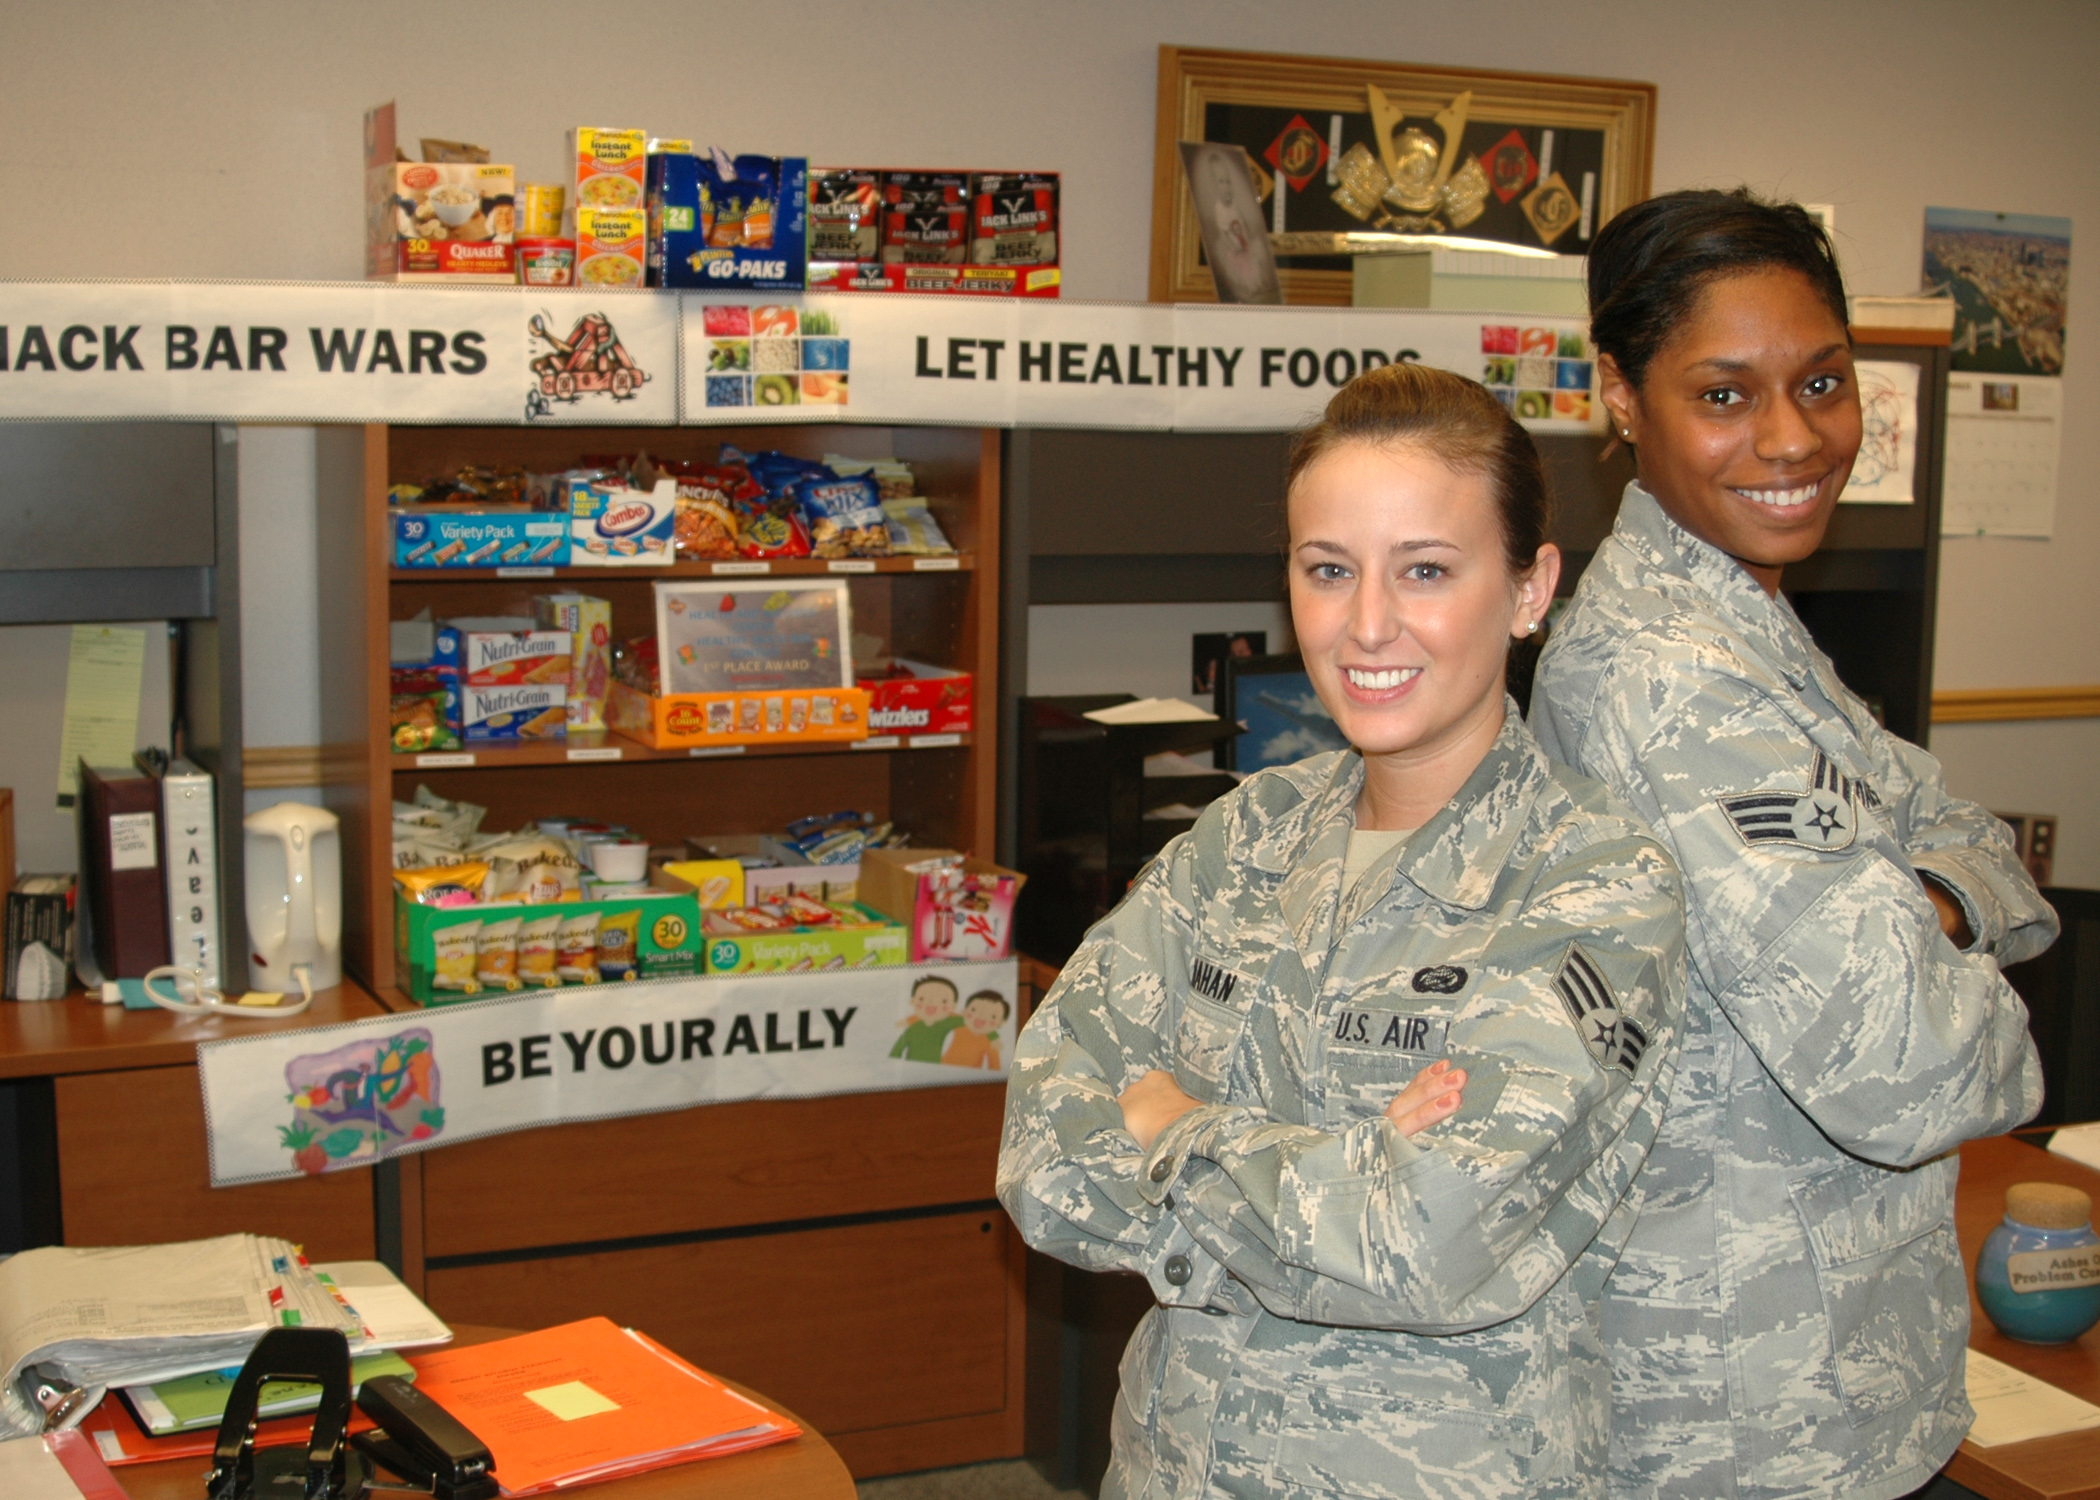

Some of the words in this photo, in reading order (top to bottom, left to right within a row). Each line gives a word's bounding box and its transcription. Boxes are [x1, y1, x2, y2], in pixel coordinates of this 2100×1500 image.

[591, 140, 632, 150] Instant
[595, 149, 627, 159] Lunch
[481, 168, 507, 176] NEW!
[668, 208, 690, 223] 24
[811, 203, 830, 215] ACK
[591, 220, 632, 230] Instant
[981, 213, 1008, 228] JACK
[1010, 210, 1047, 224] LINK'S
[595, 229, 627, 239] Lunch
[407, 238, 429, 253] 30
[450, 243, 504, 260] QUAKER
[707, 260, 787, 280] GO-PAKS
[912, 269, 950, 277] ORIGINAL
[971, 270, 1009, 278] TERIYAKI
[905, 278, 953, 290] BEEF
[953, 280, 1017, 293] JERKY
[0, 325, 145, 372] ACK
[164, 325, 288, 372] BAR
[309, 327, 488, 376] WARS
[915, 335, 1005, 380] LET
[1018, 340, 1244, 388] HEALTHY
[604, 504, 646, 528] Combos
[404, 521, 425, 538] 30
[440, 524, 483, 541] Variety
[485, 524, 515, 539] Pack
[569, 605, 579, 633] PACK
[480, 639, 556, 666] Nutri-Grain
[723, 660, 760, 672] PLACE
[764, 659, 810, 671] AWARD
[475, 689, 550, 718] Nutri-Grain
[669, 716, 700, 727] Count
[680, 709, 691, 718] 16
[868, 704, 930, 729] wizzlers
[658, 920, 683, 939] 30
[645, 952, 674, 964] Smart
[675, 950, 695, 961] Mix
[713, 943, 737, 964] 30
[752, 942, 799, 961] Variety
[800, 940, 831, 956] Pack
[1334, 1011, 1371, 1045] U.S.
[1381, 1015, 1429, 1051] AIR
[480, 1033, 553, 1087] BE
[561, 1019, 716, 1073] YOUR
[722, 1006, 859, 1058] ALLY
[2050, 1257, 2089, 1270] Ashes
[2013, 1271, 2075, 1285] Problem
